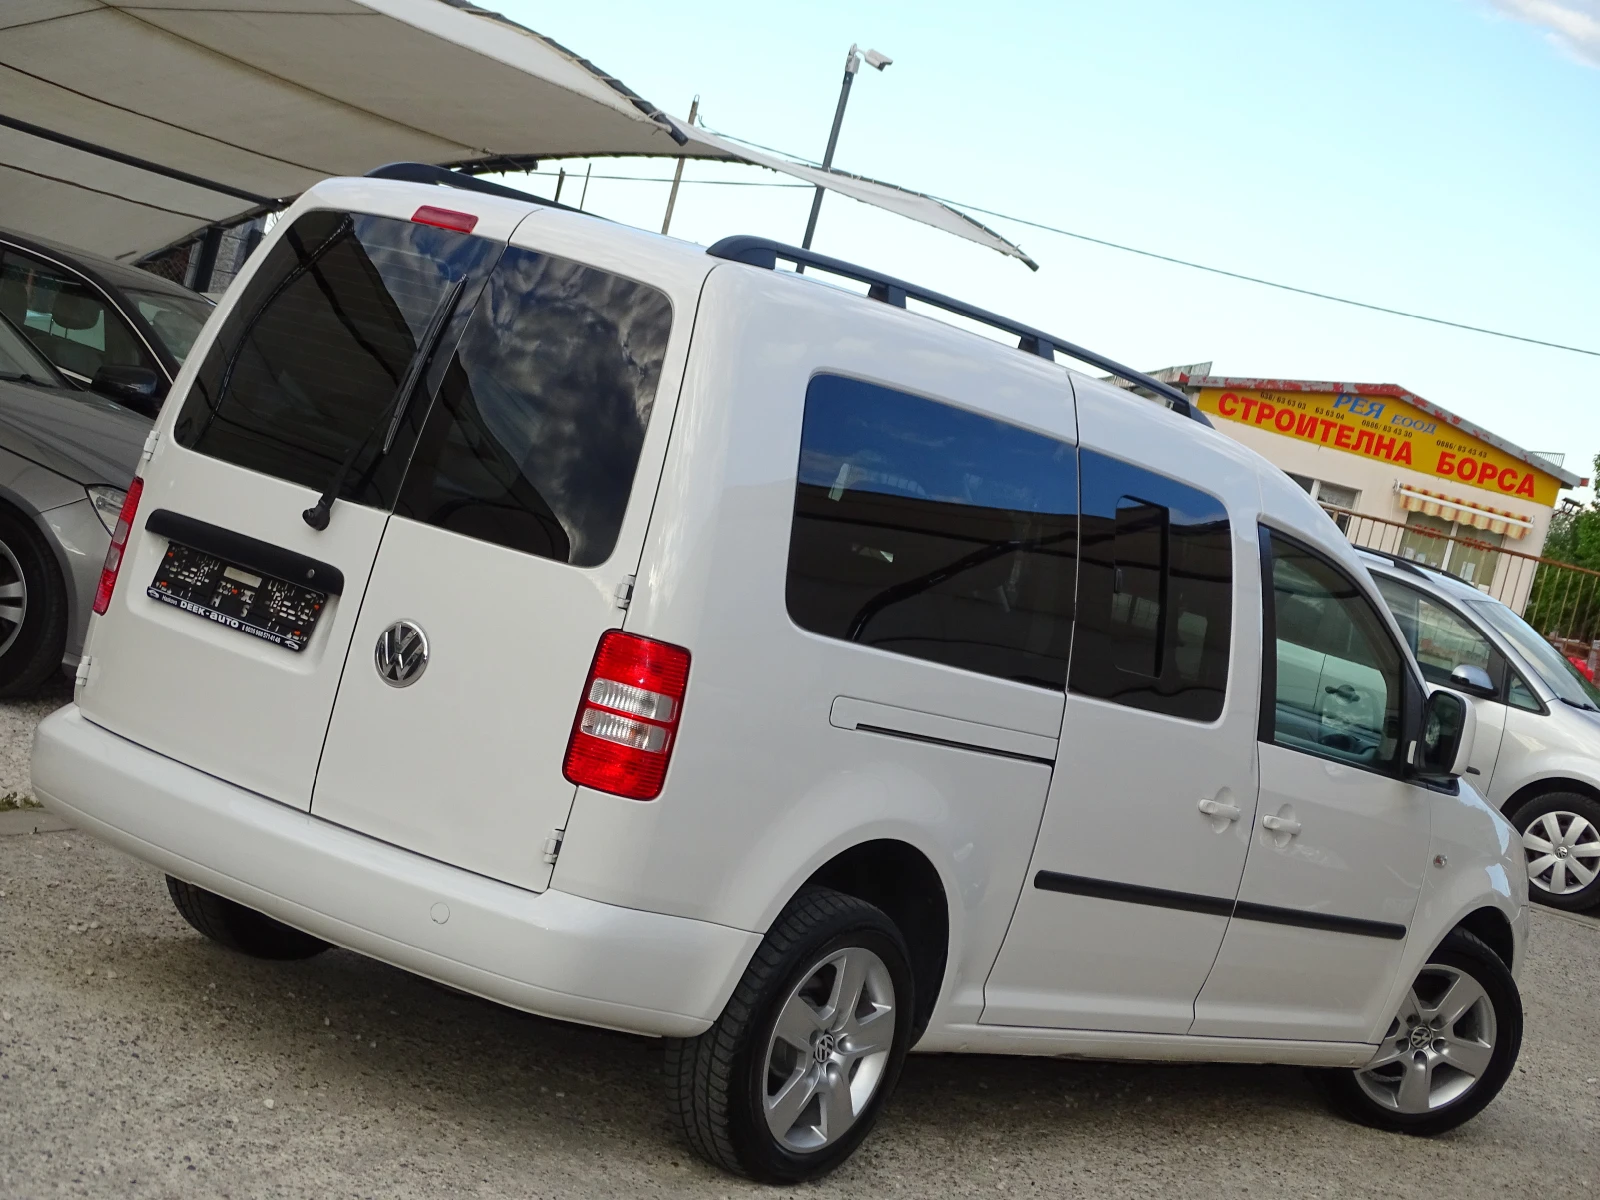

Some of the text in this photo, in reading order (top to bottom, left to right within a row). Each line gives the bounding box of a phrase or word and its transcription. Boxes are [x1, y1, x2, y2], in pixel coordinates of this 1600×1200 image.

[1218, 392, 1535, 498] СТРОИТЕЛНА БОРСА
[1333, 393, 1438, 435] РЕЯ ЕООД
[374, 620, 429, 689] VW
